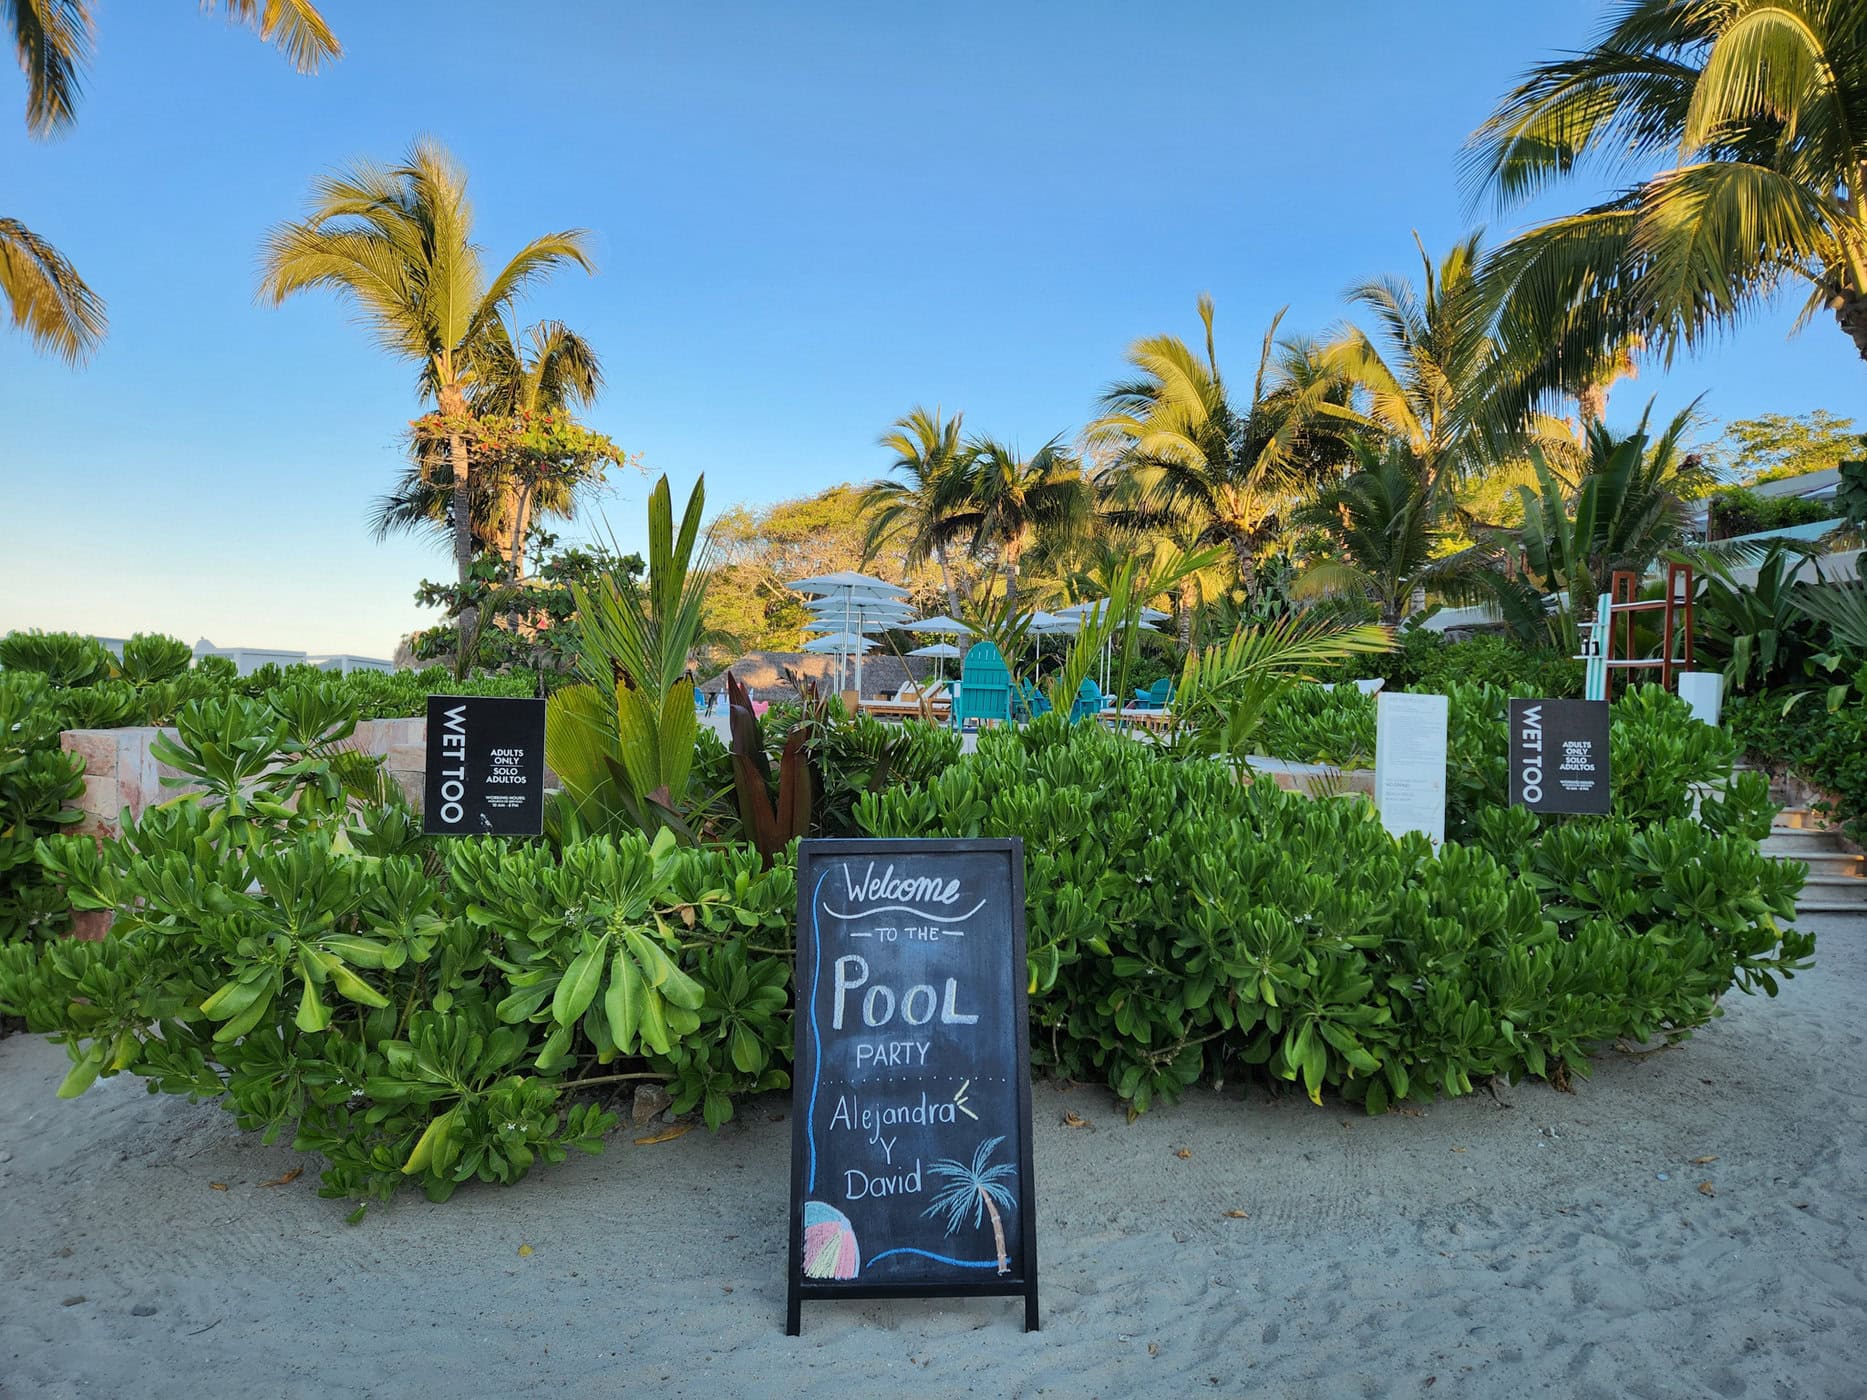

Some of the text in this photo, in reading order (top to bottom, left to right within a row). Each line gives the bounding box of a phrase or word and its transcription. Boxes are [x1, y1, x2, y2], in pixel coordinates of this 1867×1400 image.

[490, 748, 524, 757] ADULTS
[1521, 704, 1543, 803] WET TOO
[1562, 741, 1592, 749] ADULTS
[440, 704, 467, 824] WET TOO
[494, 757, 520, 765] ONLY
[1559, 763, 1596, 771] ADULTOS
[493, 767, 518, 775] SOLO
[485, 776, 527, 784] ADULTOS
[843, 860, 960, 905] Welcome
[874, 926, 940, 943] TO THE
[856, 1041, 931, 1070] PARTY
[829, 1091, 957, 1145] Alejandra
[843, 1158, 922, 1200] David
